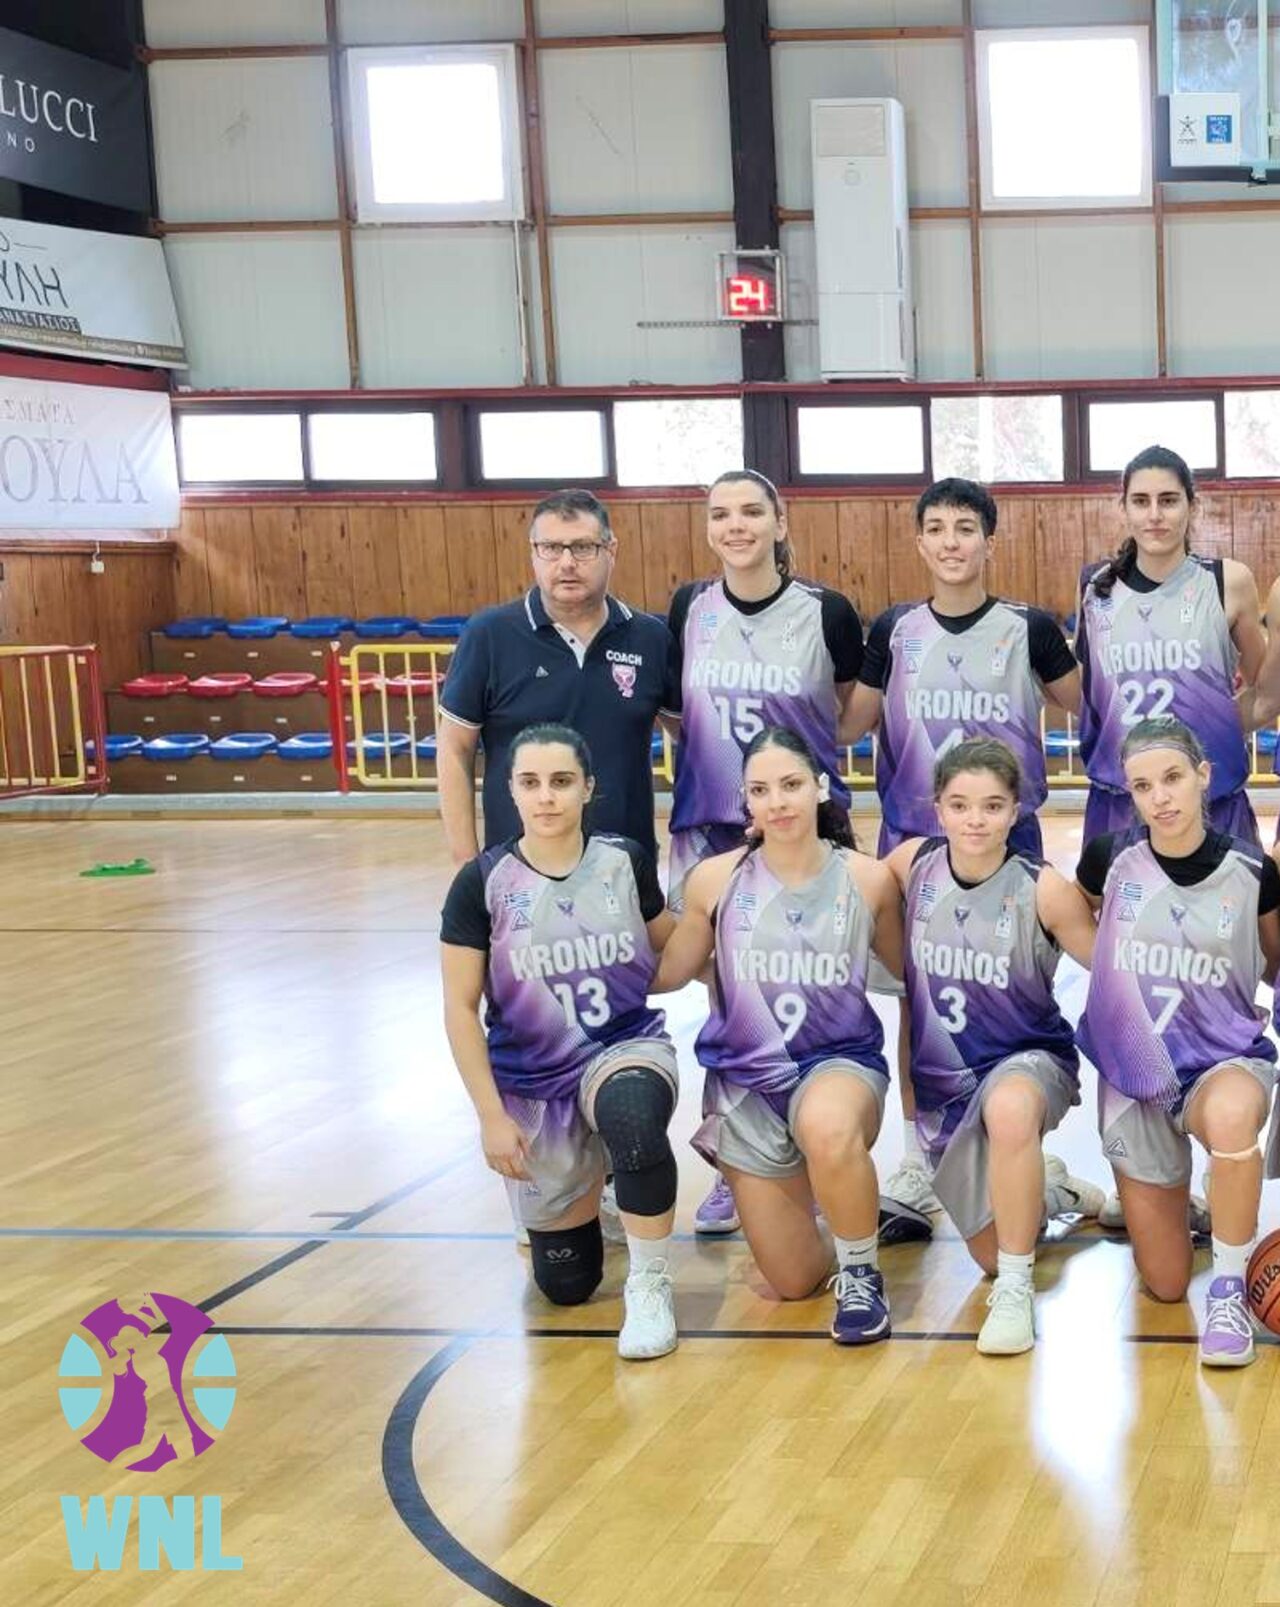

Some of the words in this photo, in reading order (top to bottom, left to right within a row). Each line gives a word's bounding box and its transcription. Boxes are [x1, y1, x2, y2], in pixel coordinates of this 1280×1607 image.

[0, 74, 98, 142] LUCCI
[730, 279, 766, 312] 24
[606, 649, 643, 667] COACH
[715, 695, 765, 743] 15
[1119, 678, 1175, 727] 22
[510, 931, 636, 982] KRONOS
[732, 948, 851, 987] KRONOS
[1113, 937, 1233, 988] KRONOS
[554, 977, 611, 1028] 13
[774, 992, 807, 1042] 9
[939, 986, 967, 1034] 3
[1151, 984, 1185, 1035] 7
